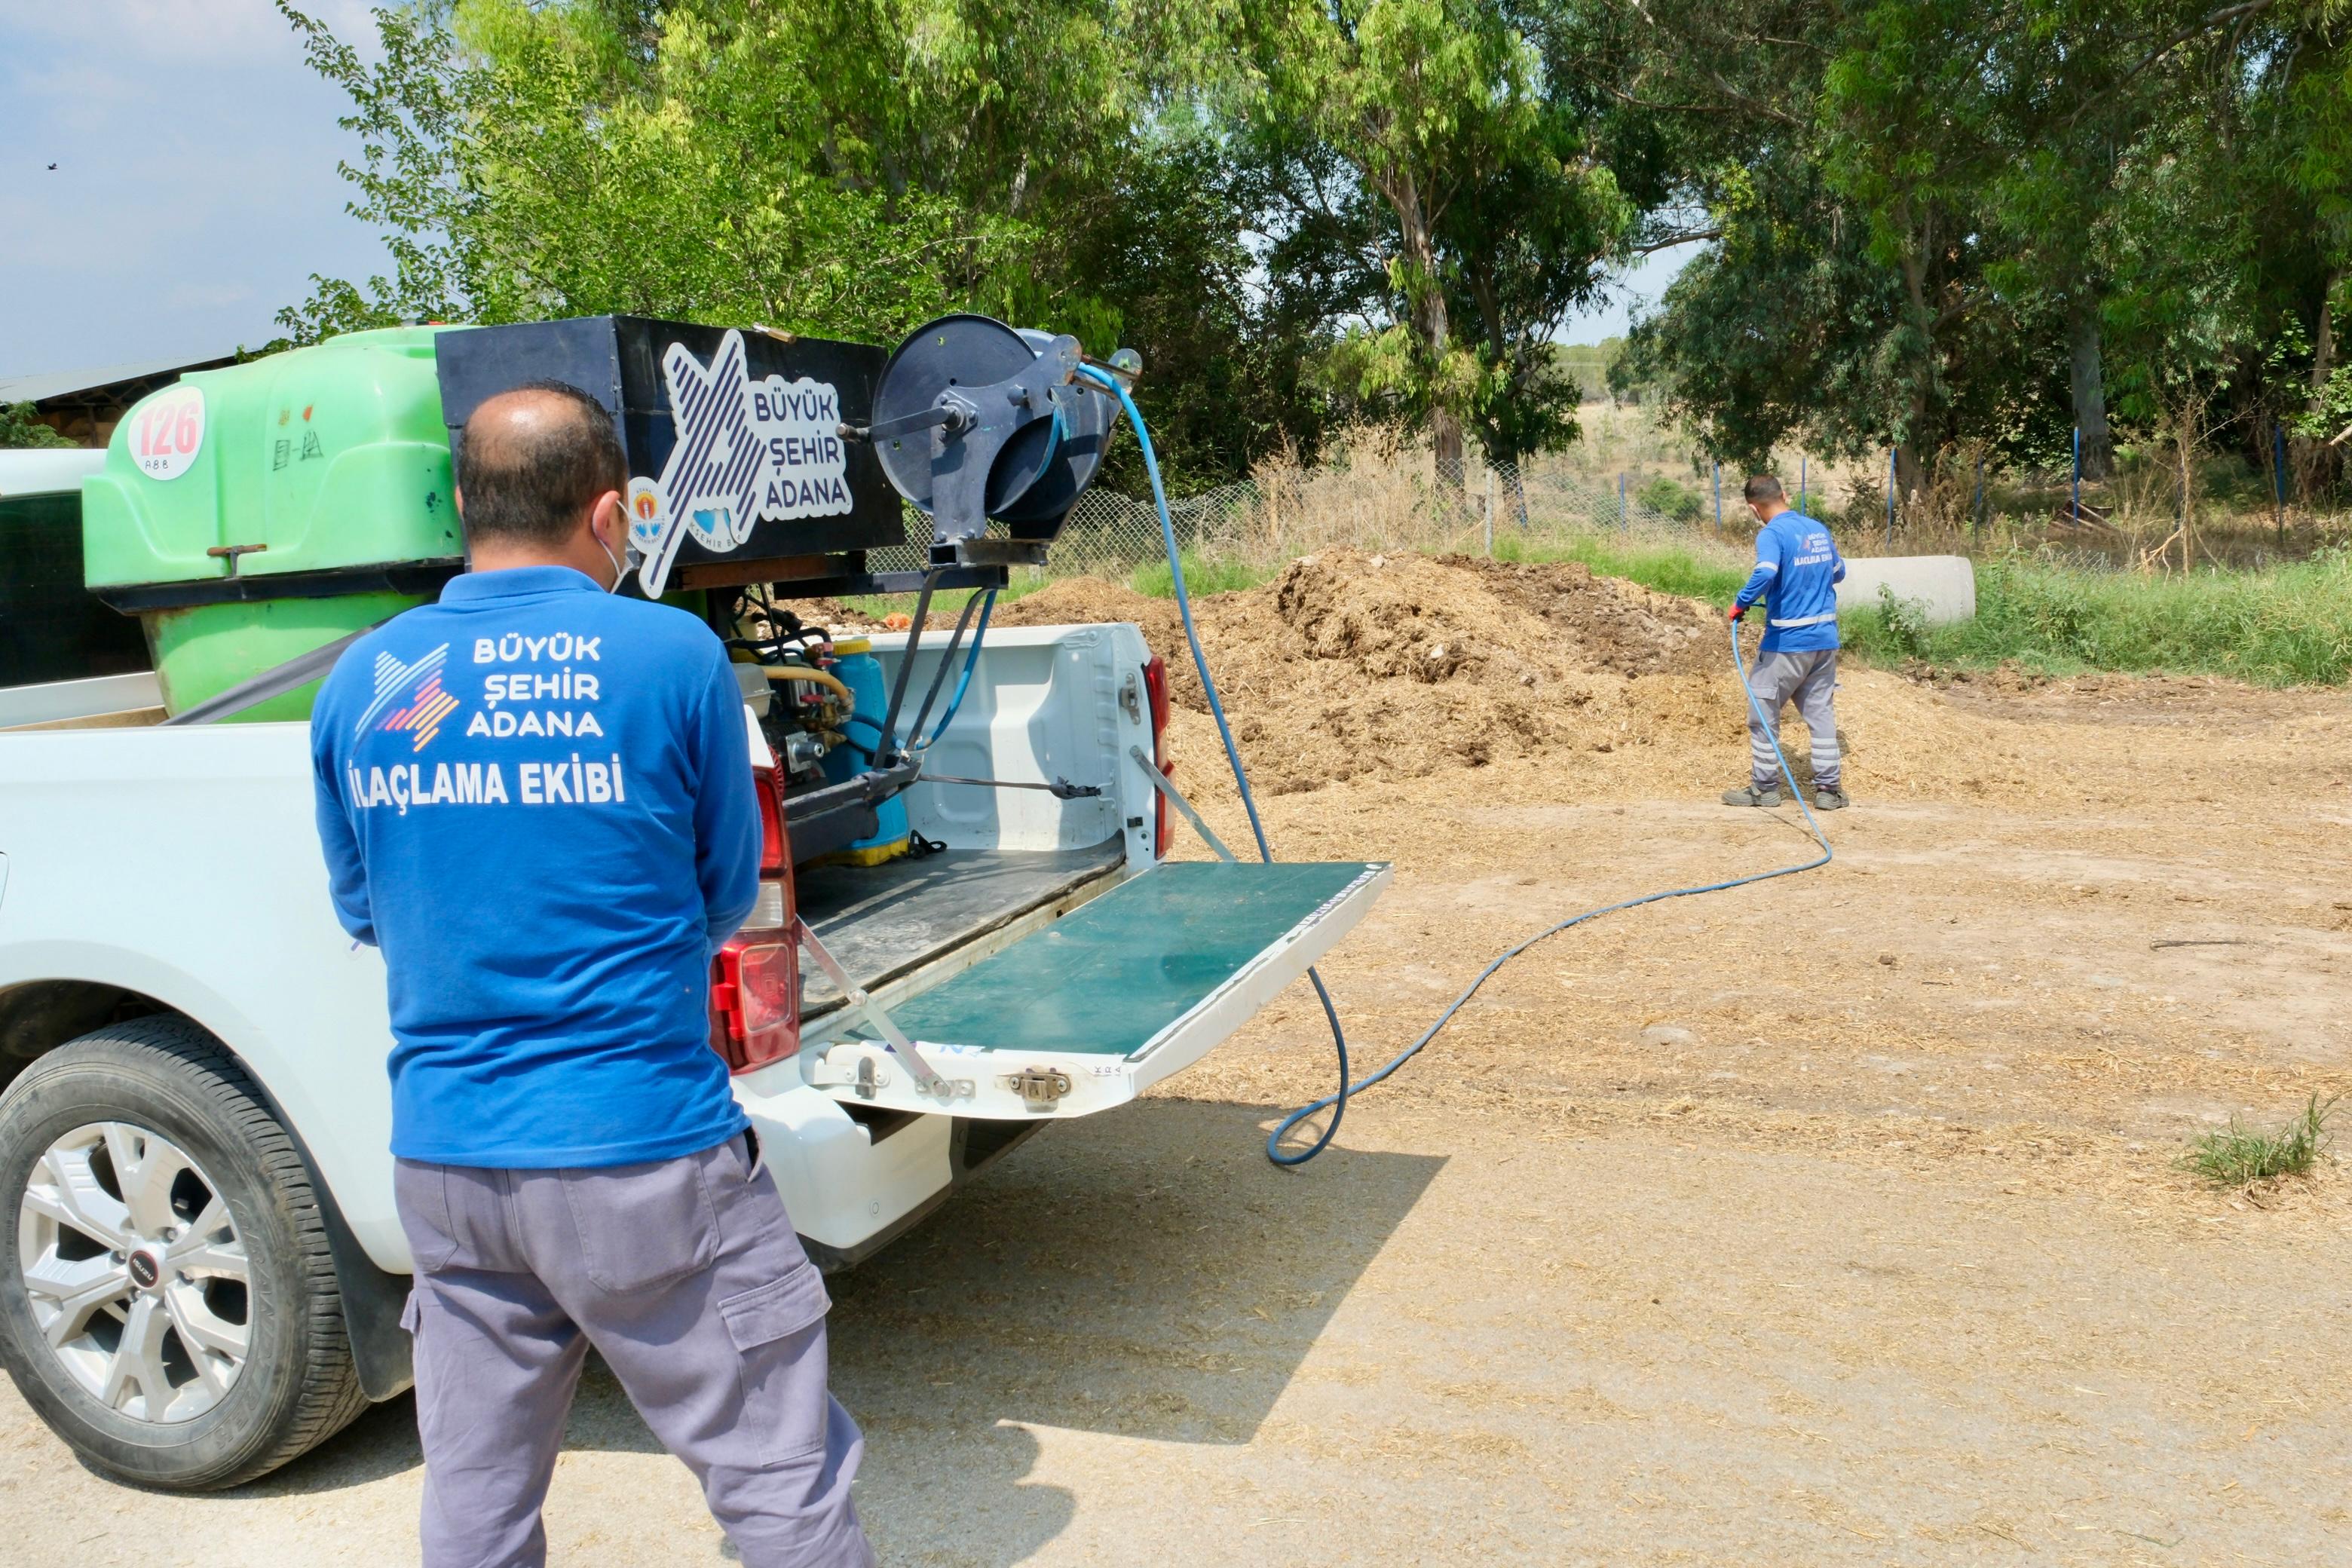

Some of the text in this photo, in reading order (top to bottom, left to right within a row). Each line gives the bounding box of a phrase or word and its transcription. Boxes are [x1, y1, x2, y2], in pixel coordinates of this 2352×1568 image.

[755, 387, 835, 421] BÜYÜK
[139, 401, 201, 456] 126
[770, 430, 840, 476] ŞEHİR
[766, 476, 847, 509] ADANA
[473, 632, 601, 663] BÜYÜK
[484, 666, 600, 709] ŞEHİR
[467, 711, 604, 737] ADANA
[348, 753, 625, 816] İLAÇLAMA EKİBİ
[133, 1258, 154, 1280] ISUZU
